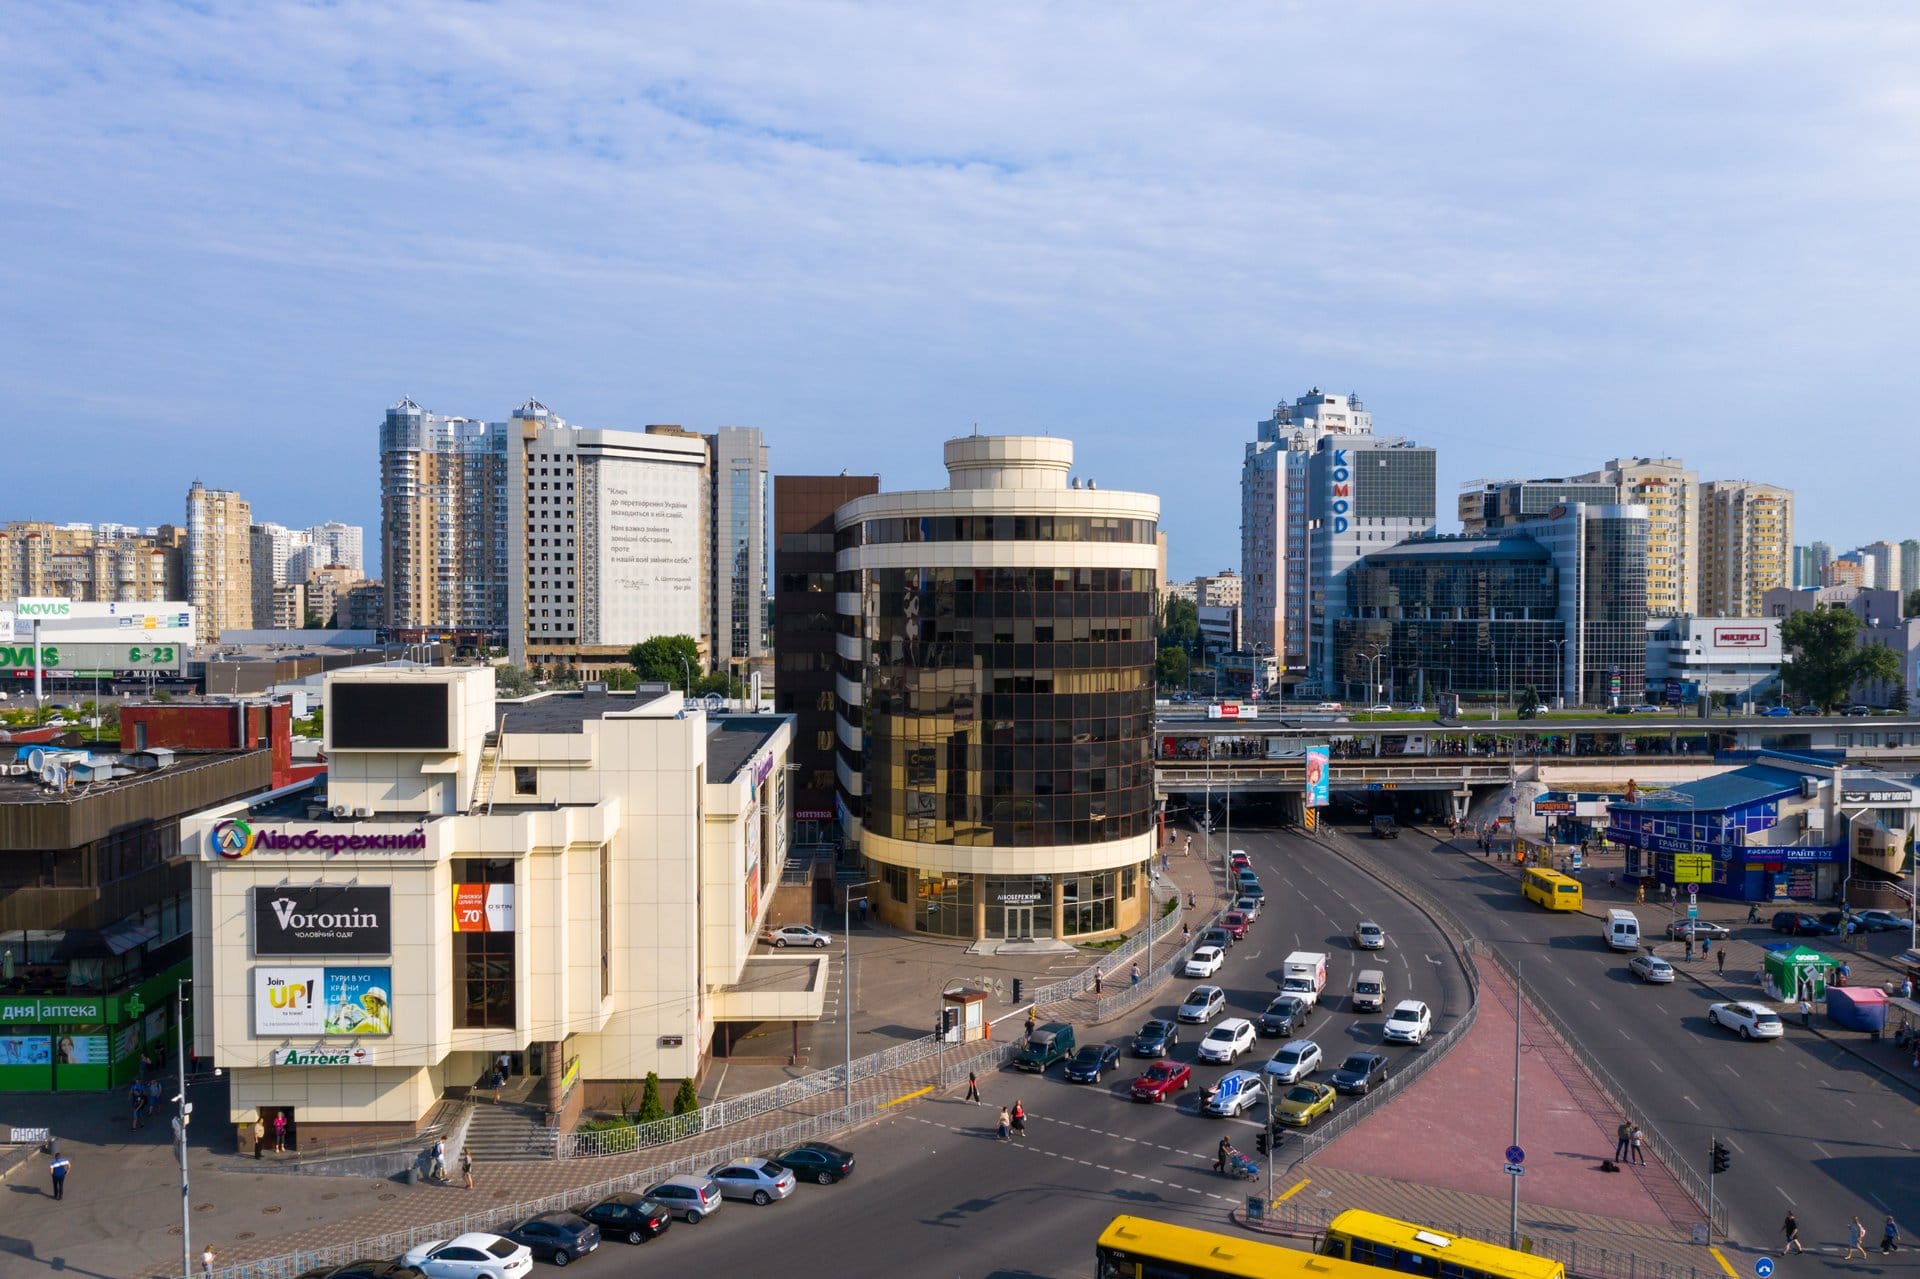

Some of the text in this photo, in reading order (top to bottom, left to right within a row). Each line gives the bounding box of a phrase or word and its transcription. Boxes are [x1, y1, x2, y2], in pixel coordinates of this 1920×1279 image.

[1333, 449, 1349, 534] KOMOD
[19, 603, 70, 615] NOVUS
[254, 828, 426, 855] Лівобережний
[271, 898, 379, 931] Voronin
[267, 977, 285, 986] Join
[269, 980, 314, 1009] UP!
[2, 1005, 97, 1020] дня аптека
[284, 1050, 350, 1065] Аптека
